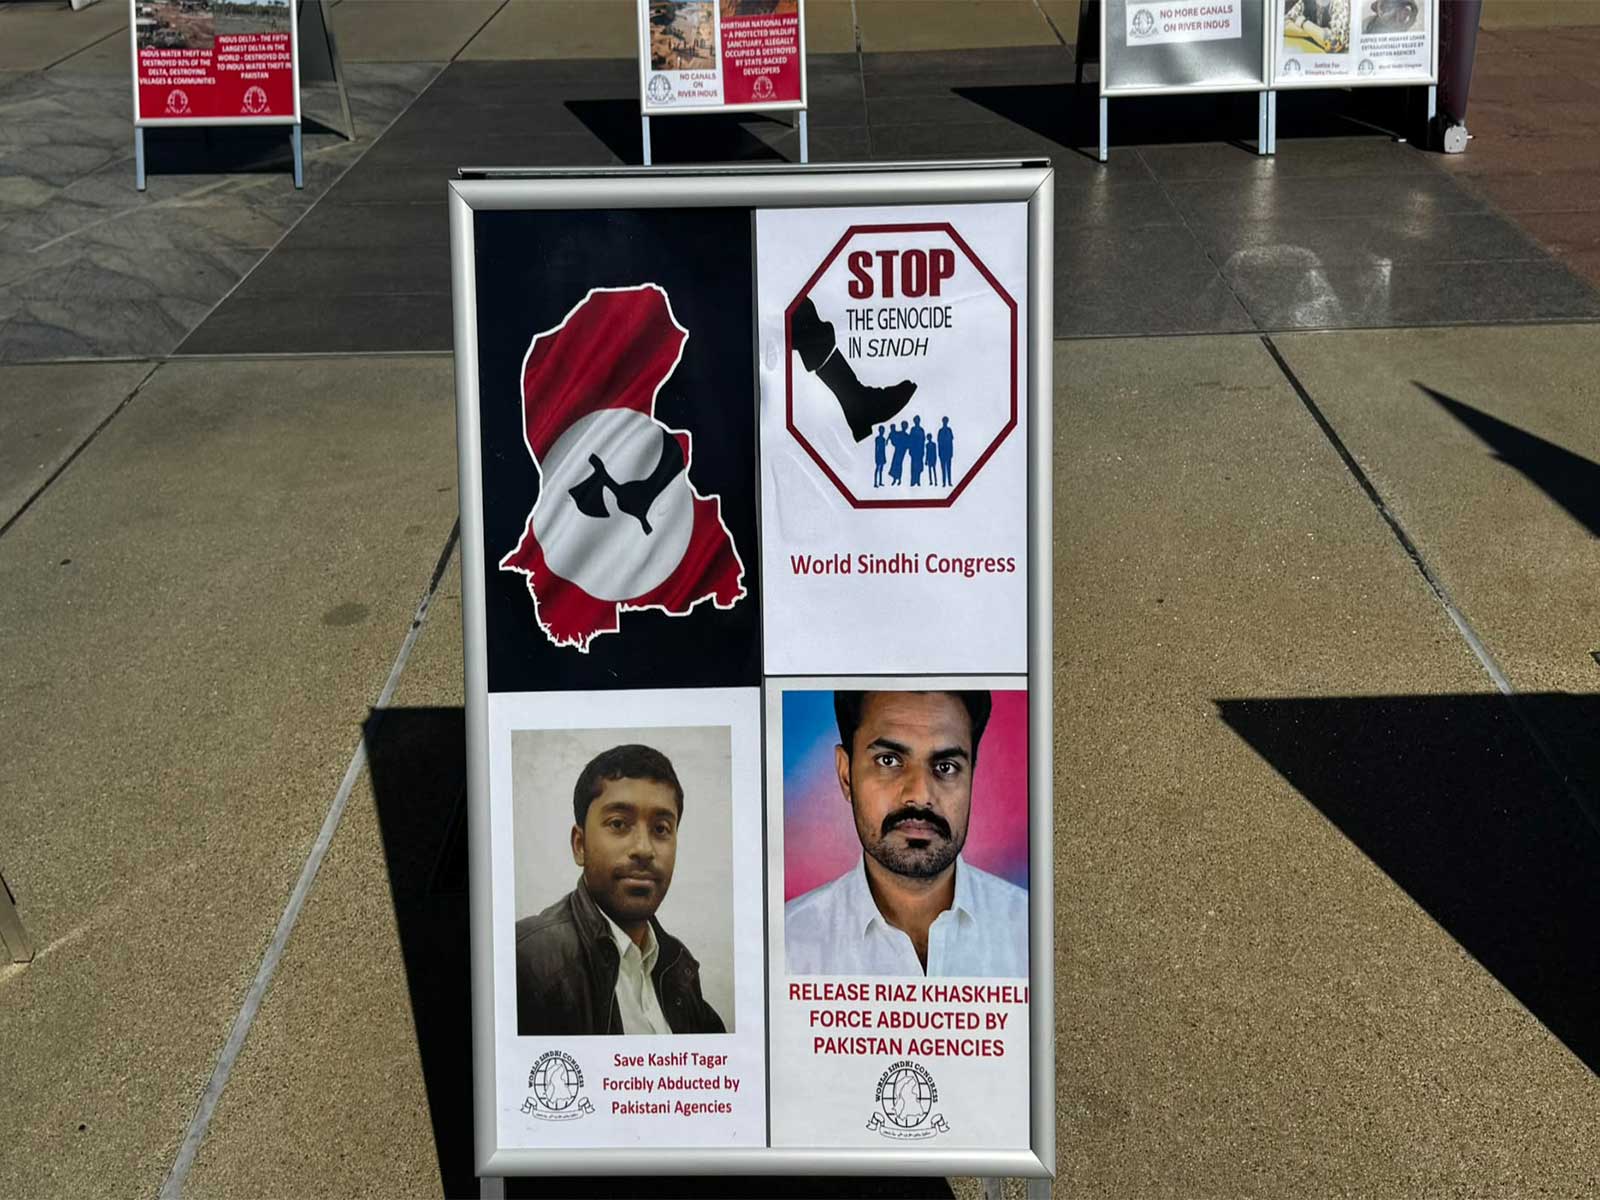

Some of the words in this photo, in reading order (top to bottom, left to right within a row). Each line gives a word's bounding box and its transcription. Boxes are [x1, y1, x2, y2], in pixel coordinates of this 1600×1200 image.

[1160, 10, 1172, 19] NO
[1174, 7, 1198, 18] MORE
[1200, 5, 1233, 16] CANALS
[735, 29, 768, 38] PROTECTED
[770, 28, 795, 36] WILDLIFE
[1164, 24, 1176, 32] ON
[1178, 22, 1201, 31] RIVER
[1204, 20, 1230, 29] INDUS
[725, 49, 754, 57] OCCUPIED
[762, 47, 796, 55] DESTROYED
[727, 40, 764, 48] SANCTUARY,
[244, 53, 276, 61] DESTROYED
[744, 57, 787, 66] STATE-BACKED
[743, 67, 780, 75] DEVELOPERS
[848, 249, 955, 299] STOP
[846, 309, 874, 330] THE
[878, 306, 952, 330] GENOCIDE
[849, 337, 861, 358] IN
[867, 338, 928, 357] SINDH
[790, 554, 851, 575] World
[858, 553, 919, 574] Sindhi
[925, 554, 1016, 578] Congress
[789, 983, 870, 1001] RELEASE
[875, 984, 917, 1002] RIAZ
[922, 985, 1029, 1004] KHASKHELI
[810, 1010, 872, 1028] FORCE
[877, 1011, 980, 1029] ABDUCTED
[985, 1012, 1008, 1030] BY
[814, 1037, 902, 1056] PAKISTAN
[907, 1039, 1005, 1057] AGENCIES
[614, 1054, 644, 1067] Save
[649, 1052, 688, 1066] Kashif
[691, 1053, 728, 1069] Tagar
[528, 1060, 540, 1088] WORLD
[875, 1071, 889, 1102] WORLD
[888, 1061, 913, 1073] SINDHI
[915, 1063, 938, 1103] CONGRESS
[603, 1077, 653, 1093] Forcibly
[656, 1076, 721, 1091] Abducted
[725, 1076, 740, 1092] by
[612, 1101, 670, 1114] Pakistani
[674, 1101, 732, 1117] Agencies
